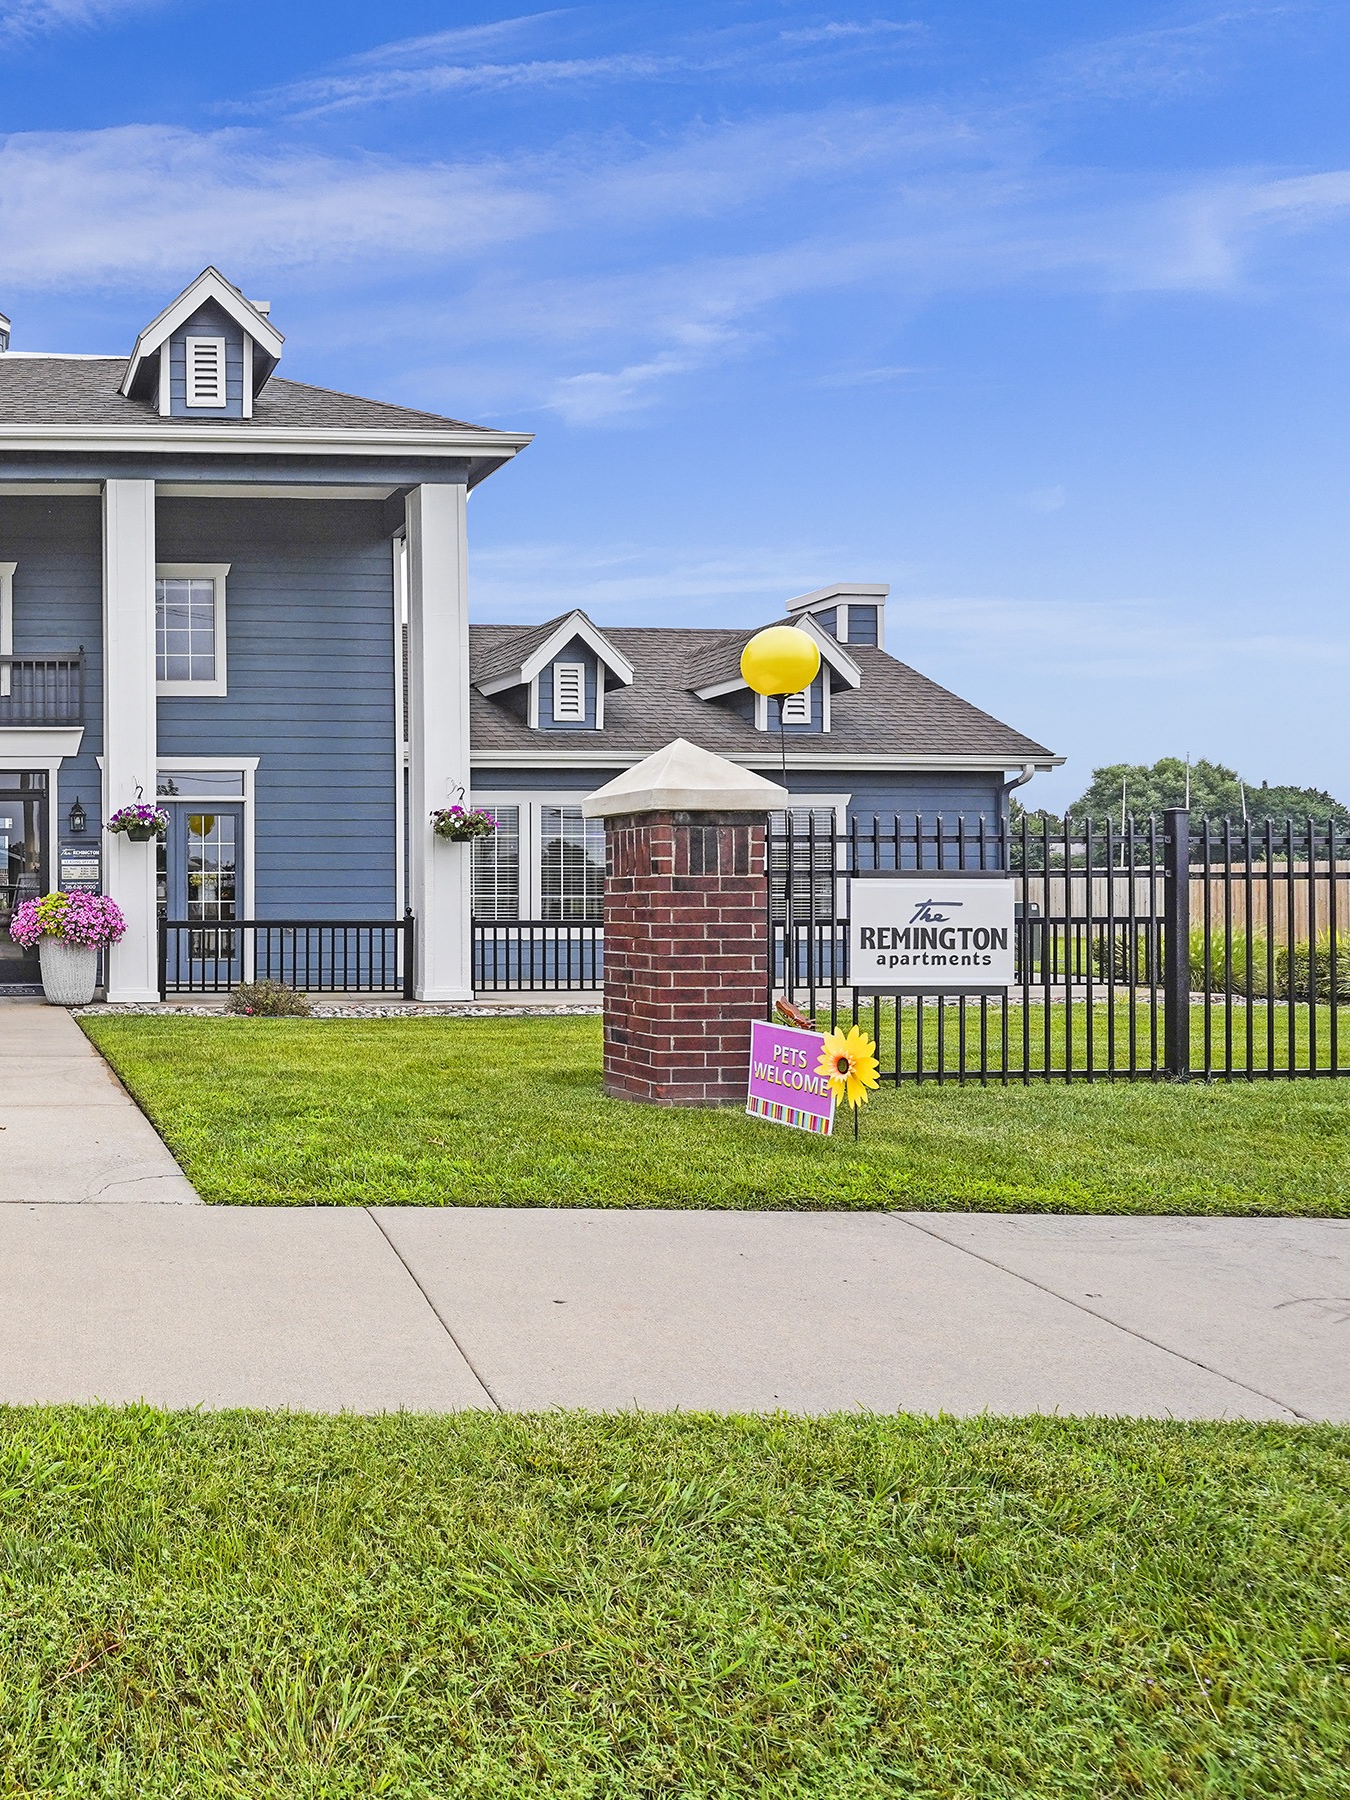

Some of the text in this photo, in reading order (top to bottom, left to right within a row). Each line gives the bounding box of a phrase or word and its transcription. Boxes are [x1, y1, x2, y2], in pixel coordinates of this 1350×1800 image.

[909, 898, 964, 924] The
[860, 926, 1008, 950] REMINGTON
[876, 952, 992, 968] apartments
[773, 1044, 808, 1069] PETS
[754, 1060, 829, 1098] WELCOME
